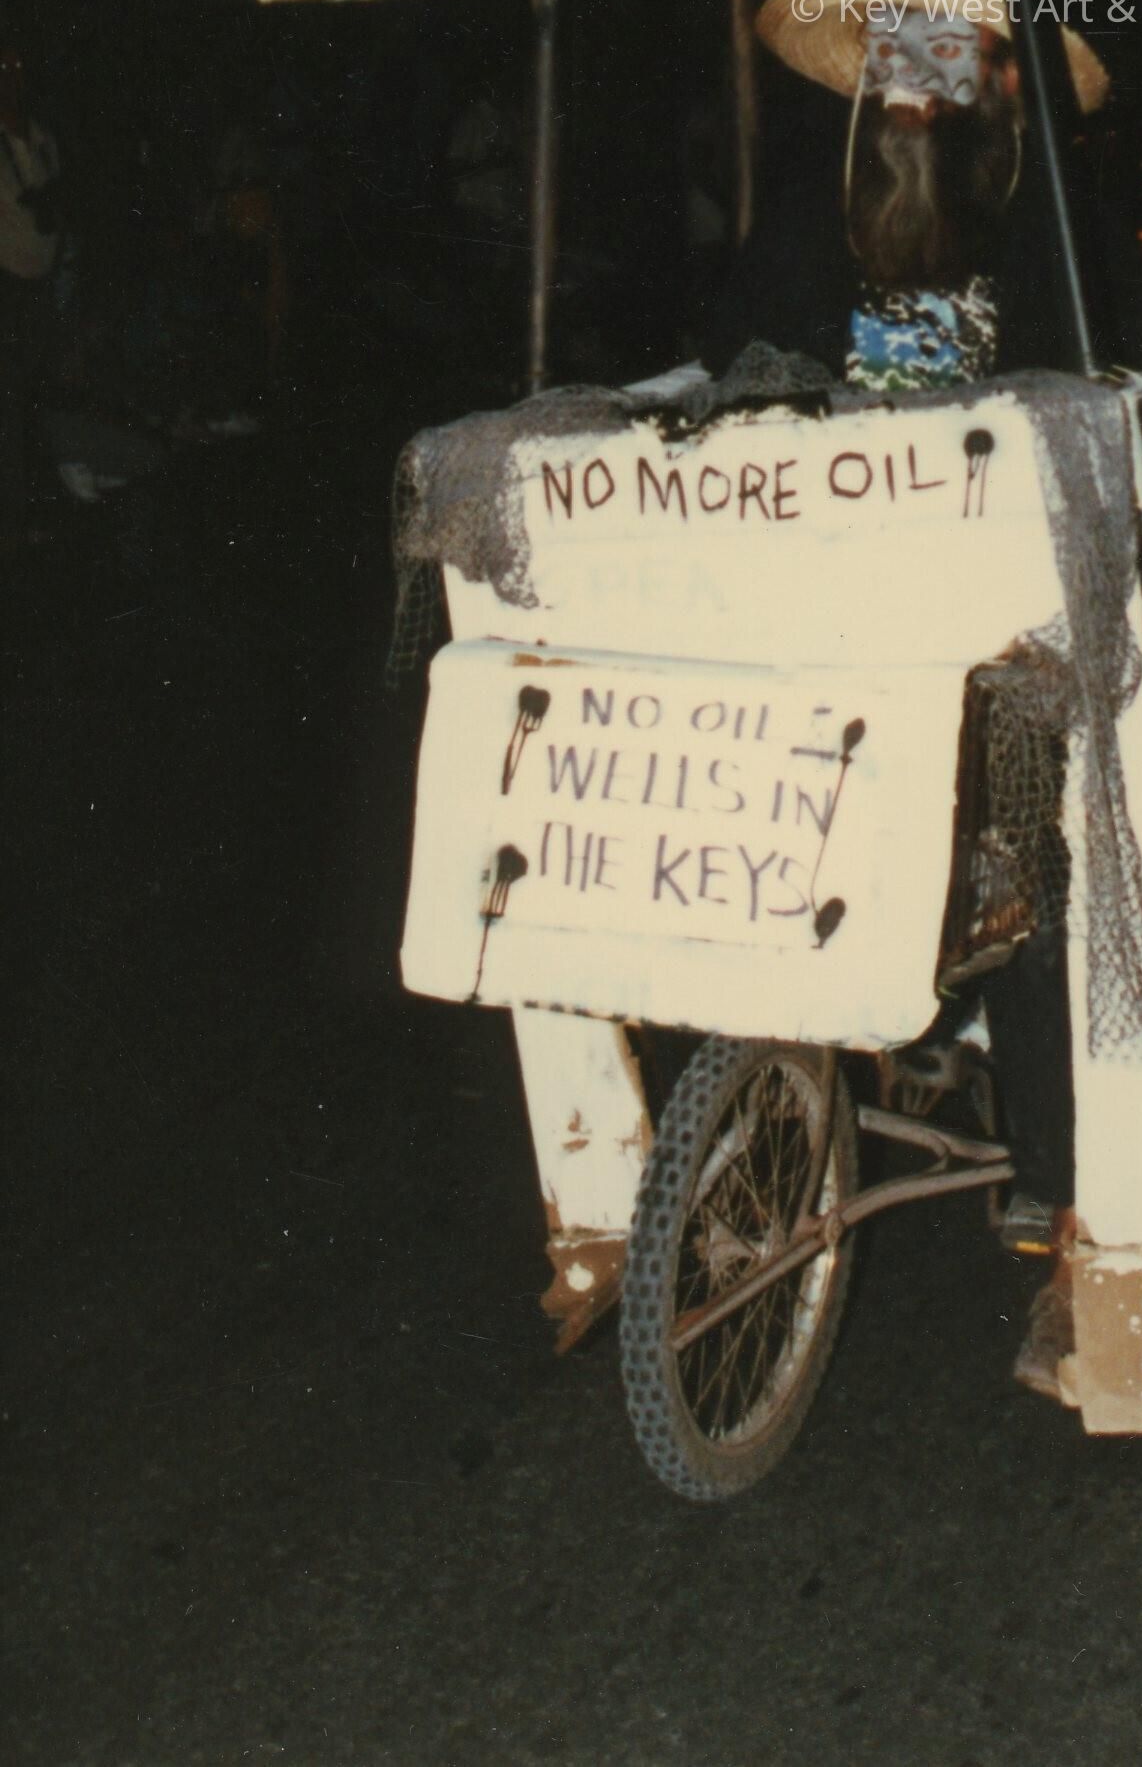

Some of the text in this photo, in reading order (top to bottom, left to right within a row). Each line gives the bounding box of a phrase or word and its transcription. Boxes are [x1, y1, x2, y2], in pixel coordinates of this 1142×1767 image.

[542, 443, 948, 522] NO MORE OIL
[581, 687, 662, 728] NO
[547, 743, 834, 837] WELLS IN
[539, 820, 811, 922] THE KEYS
